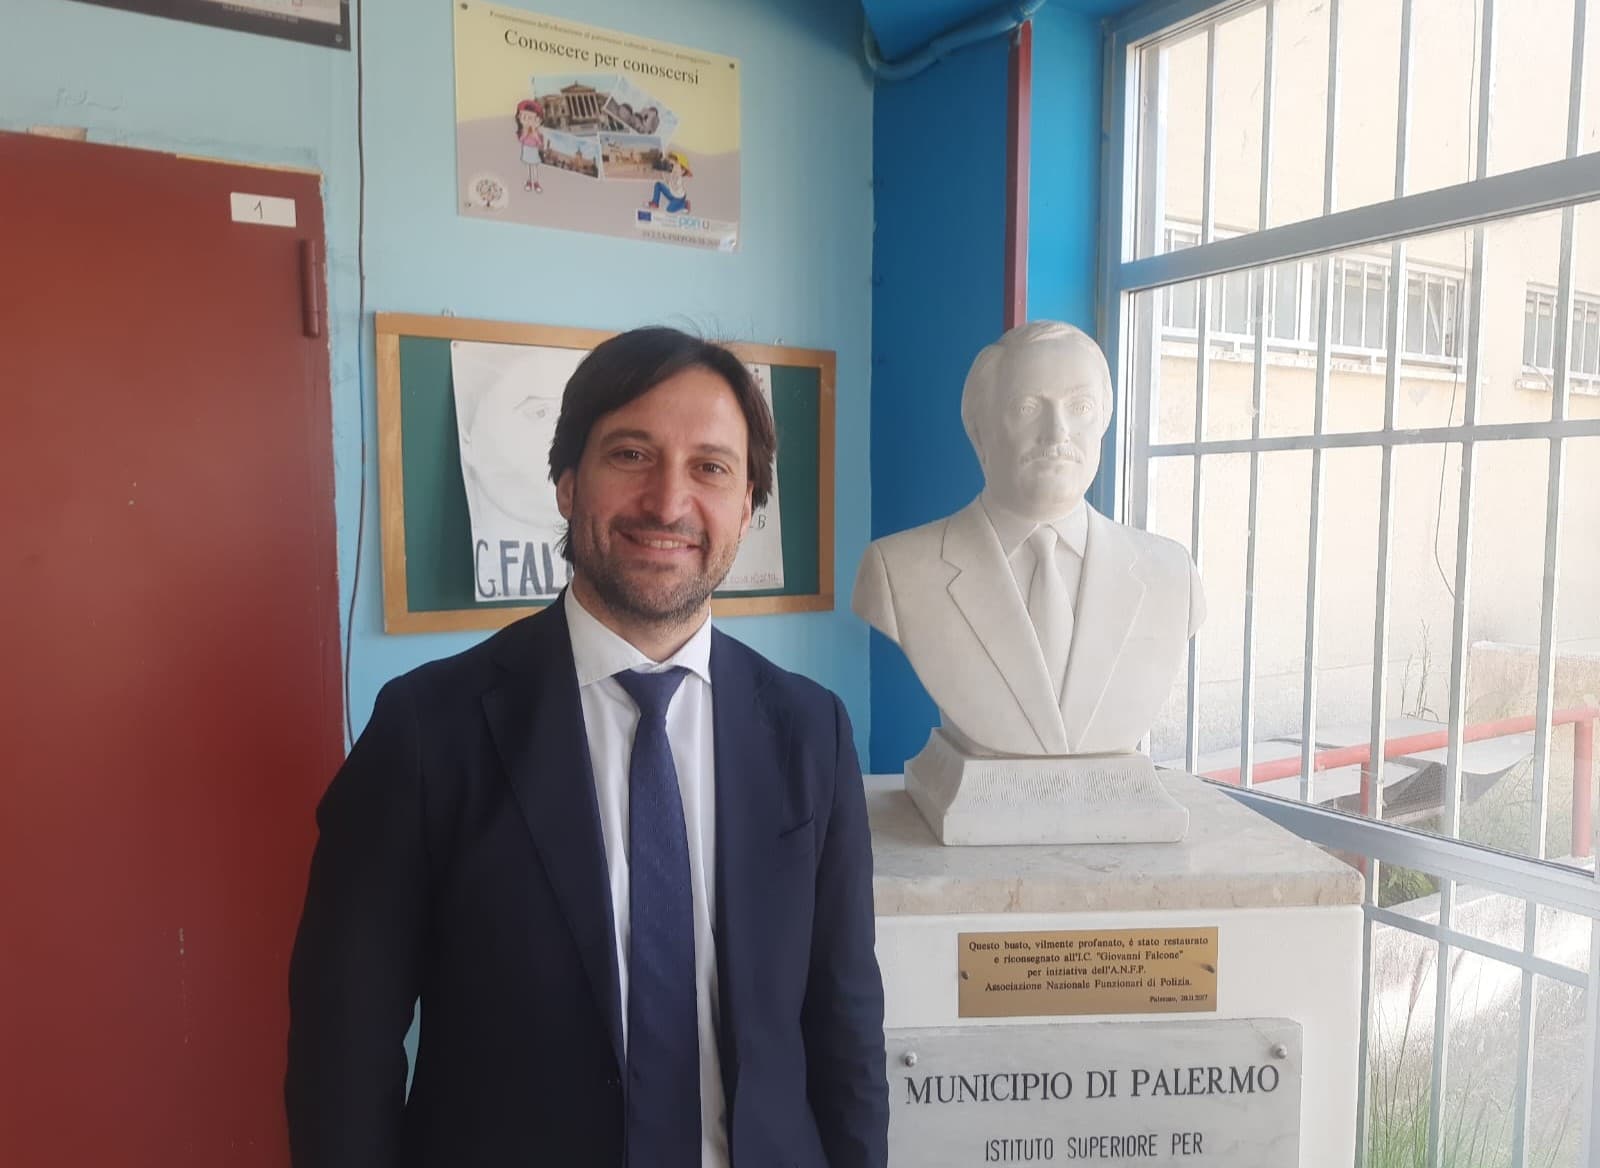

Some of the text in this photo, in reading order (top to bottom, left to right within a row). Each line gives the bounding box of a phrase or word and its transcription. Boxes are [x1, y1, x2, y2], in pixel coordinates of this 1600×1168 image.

[504, 28, 590, 61] Conoscere
[594, 51, 619, 68] per
[623, 58, 699, 85] conoscersi
[253, 199, 264, 220] 1
[969, 941, 1000, 951] Questo
[1004, 941, 1031, 950] busto,
[1035, 939, 1074, 949] vilmente
[1078, 938, 1125, 949] profanato,
[1138, 938, 1160, 946] stato
[1164, 937, 1209, 946] restaurato
[1004, 954, 1060, 965] riconsegnato
[1096, 950, 1141, 961] "Giovanni
[1145, 950, 1184, 960] Falcone"
[1027, 965, 1146, 978] per iniziativa dell'A.N.F.P.
[985, 976, 1193, 992] Associazione Nazionale Funzionari di Polizia.
[904, 1064, 1280, 1104] MUNICIPIO DI PALERMO
[985, 1132, 1203, 1162] ISTITUTO SUPERIORE PER
